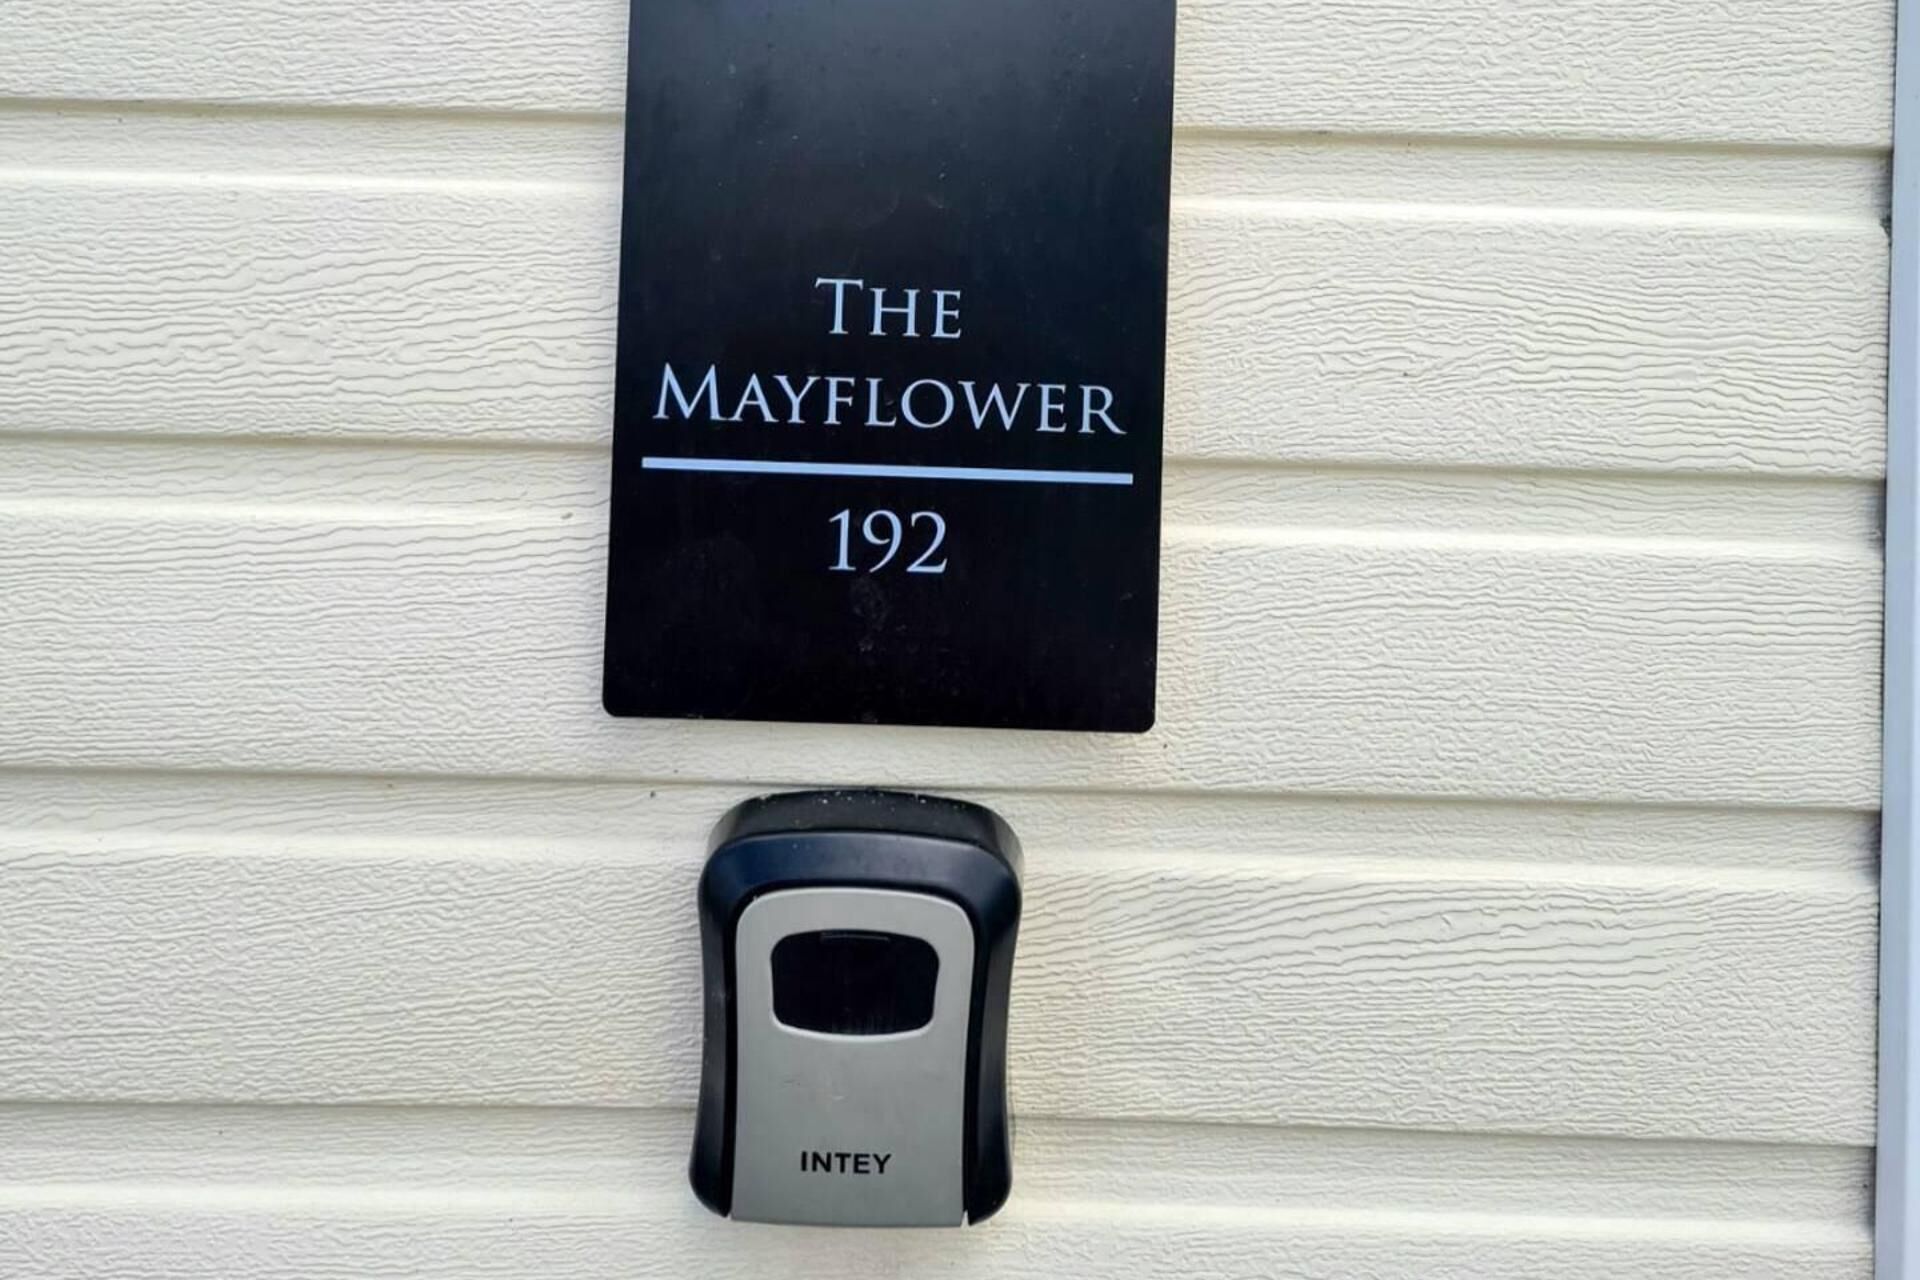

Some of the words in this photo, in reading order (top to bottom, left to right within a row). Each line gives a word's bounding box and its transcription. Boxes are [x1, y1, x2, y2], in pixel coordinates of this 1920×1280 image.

[814, 277, 963, 339] THE
[653, 362, 1127, 435] MAYFLOWER
[829, 509, 948, 574] 192
[800, 1150, 892, 1175] INTEY
